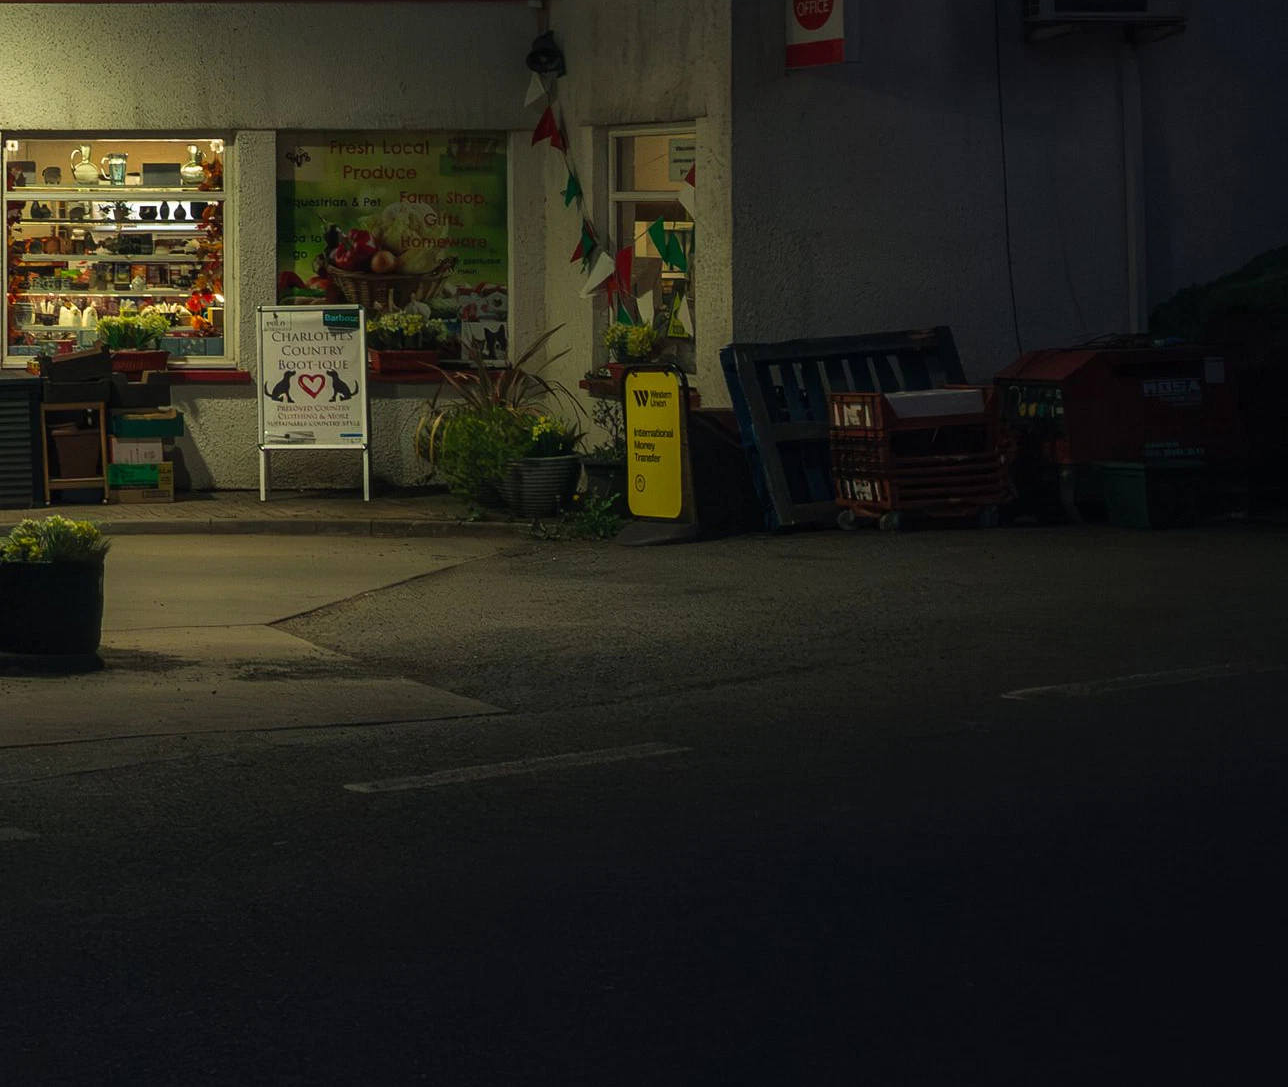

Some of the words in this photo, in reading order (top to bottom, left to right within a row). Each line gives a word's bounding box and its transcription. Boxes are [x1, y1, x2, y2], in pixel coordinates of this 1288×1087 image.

[330, 140, 375, 156] Fresh
[382, 140, 430, 155] Local
[343, 165, 417, 180] Produce
[363, 198, 381, 207] Pet
[399, 191, 439, 204] Farm
[400, 235, 488, 249] Homeware
[293, 249, 308, 260] go
[324, 314, 359, 323] Barbour
[281, 345, 344, 356] COUNTRY
[278, 359, 349, 371] BOOT-IQUE
[650, 399, 667, 408] Union
[633, 427, 674, 439] International
[634, 441, 655, 452] Money
[634, 453, 661, 463] Transfer
